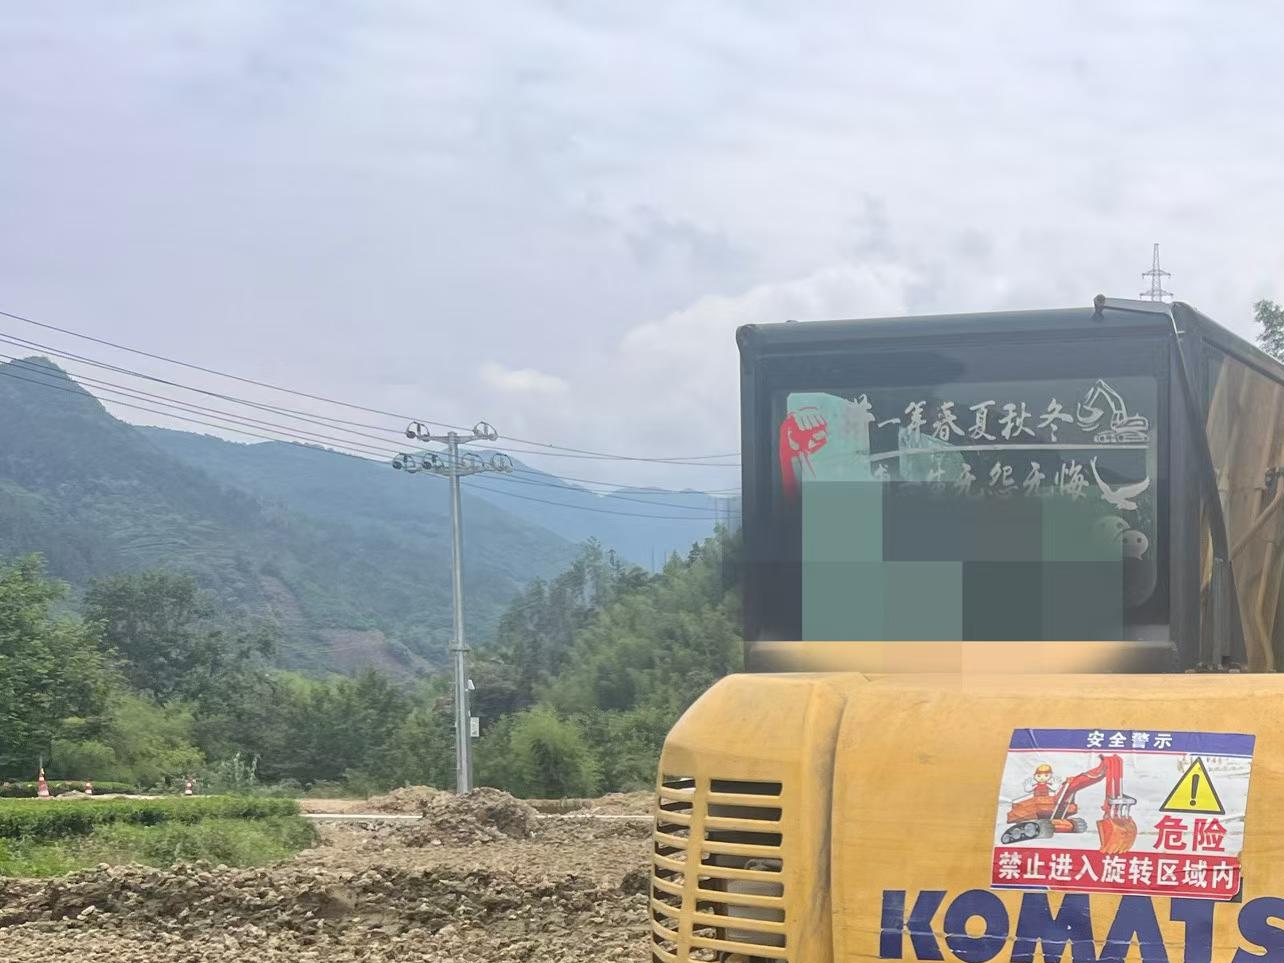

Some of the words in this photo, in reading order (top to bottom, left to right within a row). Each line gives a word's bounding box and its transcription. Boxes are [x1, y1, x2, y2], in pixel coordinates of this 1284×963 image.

[1086, 730, 1174, 749] 安全警示
[1153, 815, 1228, 852] 危险
[998, 851, 1234, 890] 禁止进入旋转区域内
